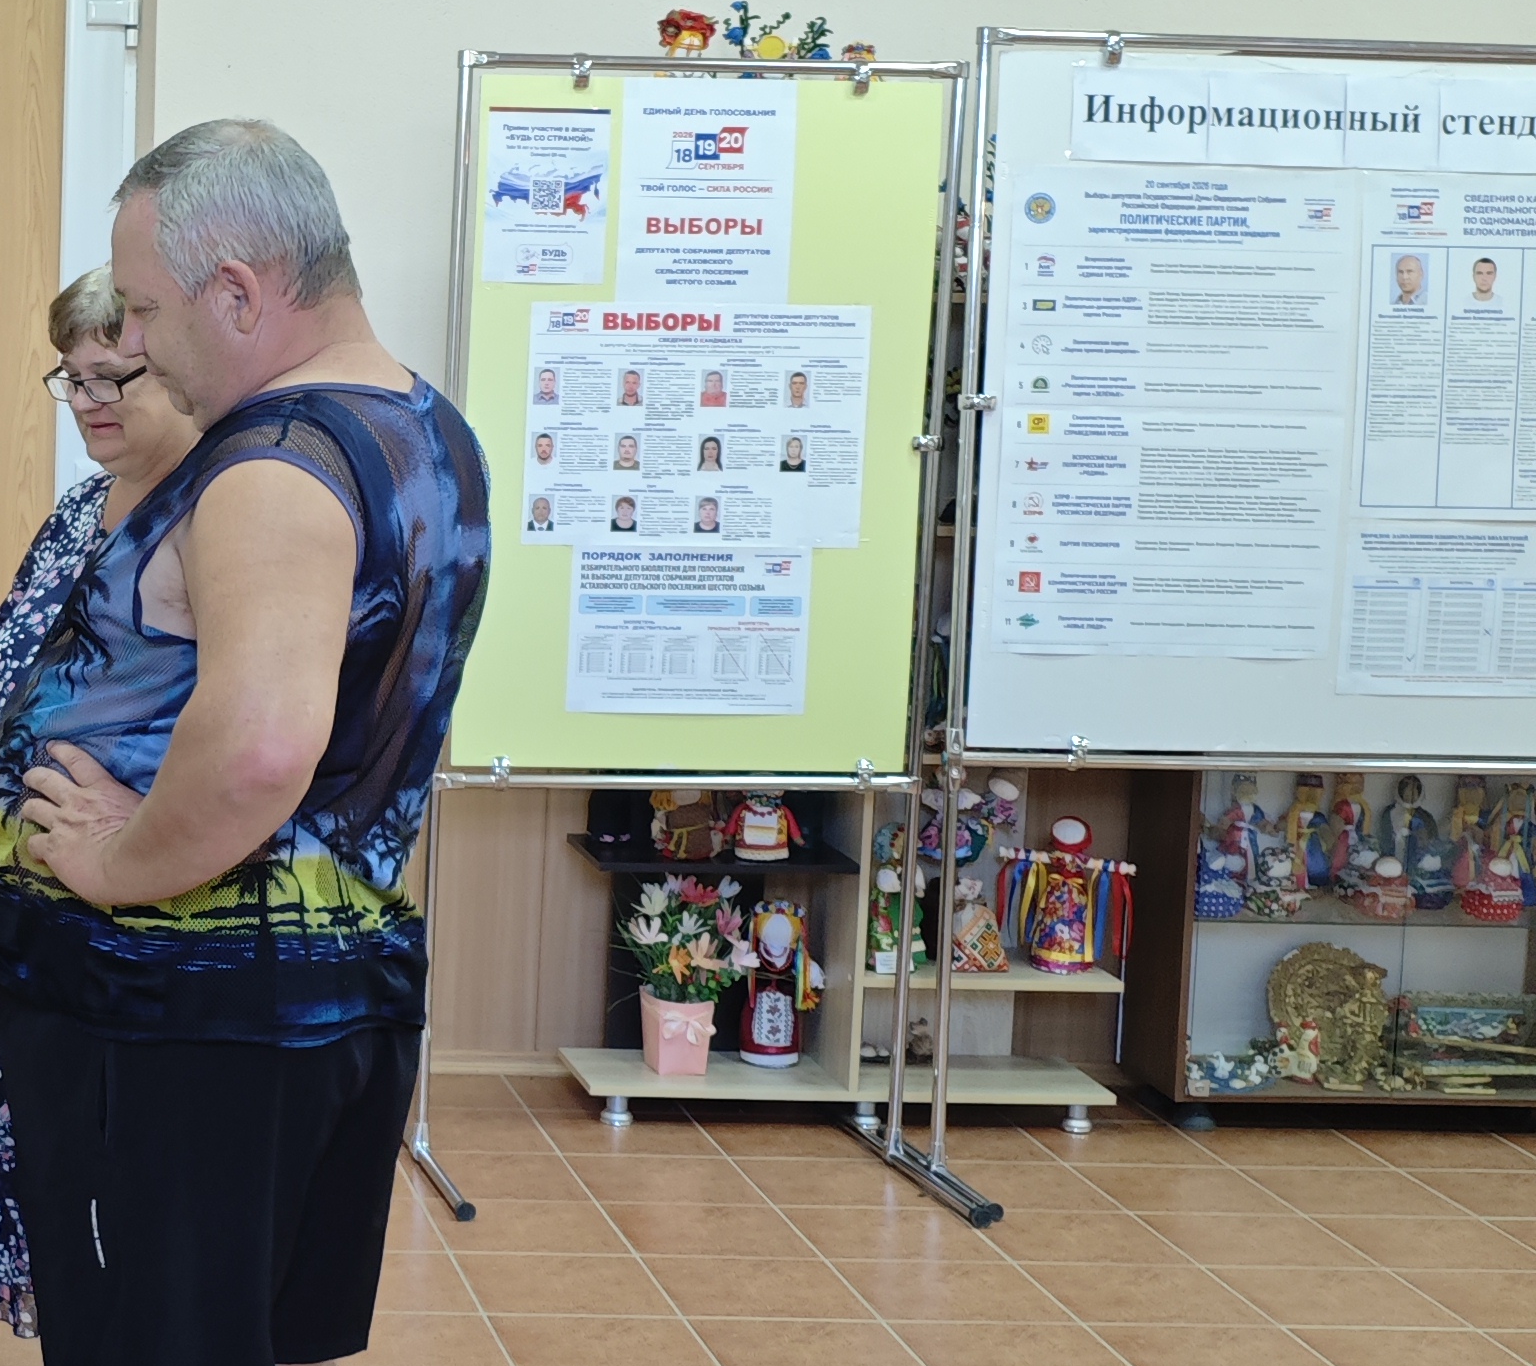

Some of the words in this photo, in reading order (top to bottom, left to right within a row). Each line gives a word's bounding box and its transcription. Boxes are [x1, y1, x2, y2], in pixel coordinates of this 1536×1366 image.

[643, 107, 681, 116] ЕДИНЫЙ
[683, 108, 707, 116] ДЕНЬ
[709, 109, 776, 117] ГОЛОСОВАНИЯ
[1083, 94, 1421, 133] Информационный
[1442, 115, 1536, 139] стенд
[674, 148, 693, 163] 18
[697, 140, 716, 155] 19
[719, 133, 743, 148] 20
[640, 184, 665, 192] ТВОЙ
[706, 185, 731, 193] СИЛА
[1464, 194, 1515, 203] СВЕДЕНИЯ
[1517, 195, 1524, 203] О
[646, 217, 763, 235] ВЫБОРЫ
[1120, 214, 1203, 226] ПОЛИТИЧЕСКИЕ
[1206, 216, 1250, 228] ПАРТИИ,
[1464, 217, 1477, 225] ПО
[1479, 217, 1536, 226] ОДНОМАНД
[541, 249, 567, 257] БУДЬ
[551, 318, 561, 329] 18
[564, 315, 574, 324] 19
[576, 311, 588, 321] 20
[603, 312, 721, 332] ВЫБОРЫ
[582, 552, 642, 562] ПОРЯДОК
[648, 552, 733, 562] ЗАПОЛНЕНИЯ
